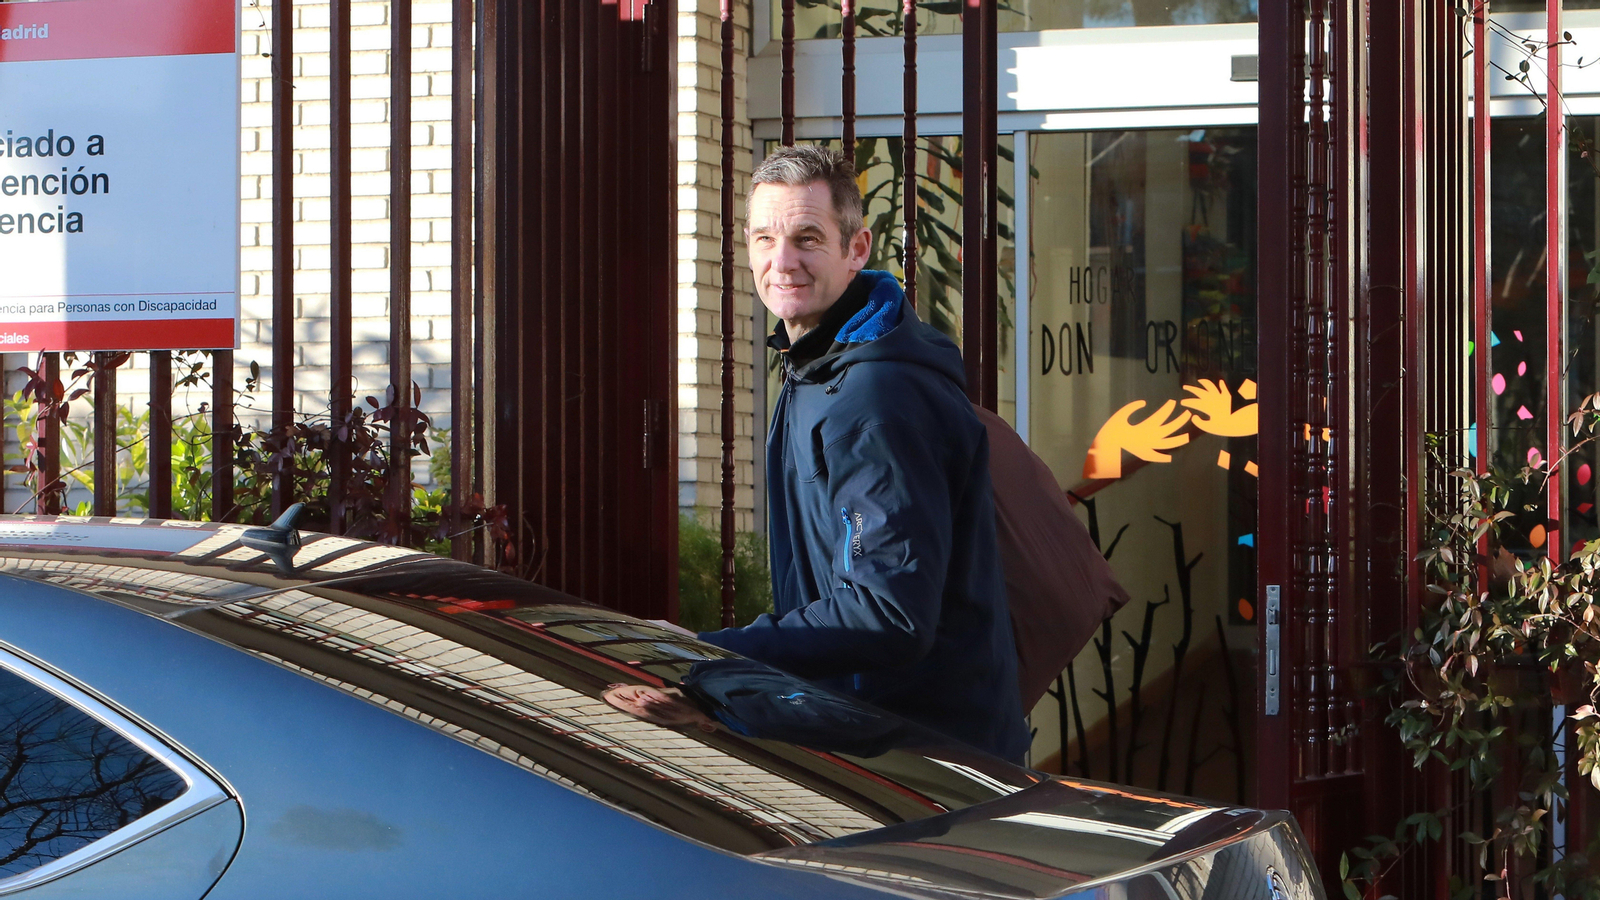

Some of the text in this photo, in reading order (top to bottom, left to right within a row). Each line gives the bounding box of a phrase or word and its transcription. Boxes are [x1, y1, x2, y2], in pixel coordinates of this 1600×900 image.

[0, 23, 49, 40] adrid
[0, 129, 105, 158] iado a
[1, 166, 109, 196] ención
[0, 205, 84, 235] encia
[1069, 266, 1137, 304] HOGAR
[29, 304, 54, 316] para
[57, 301, 111, 313] Personas
[113, 302, 135, 312] con
[138, 299, 217, 313] Discapacidad
[1041, 322, 1094, 376] DON
